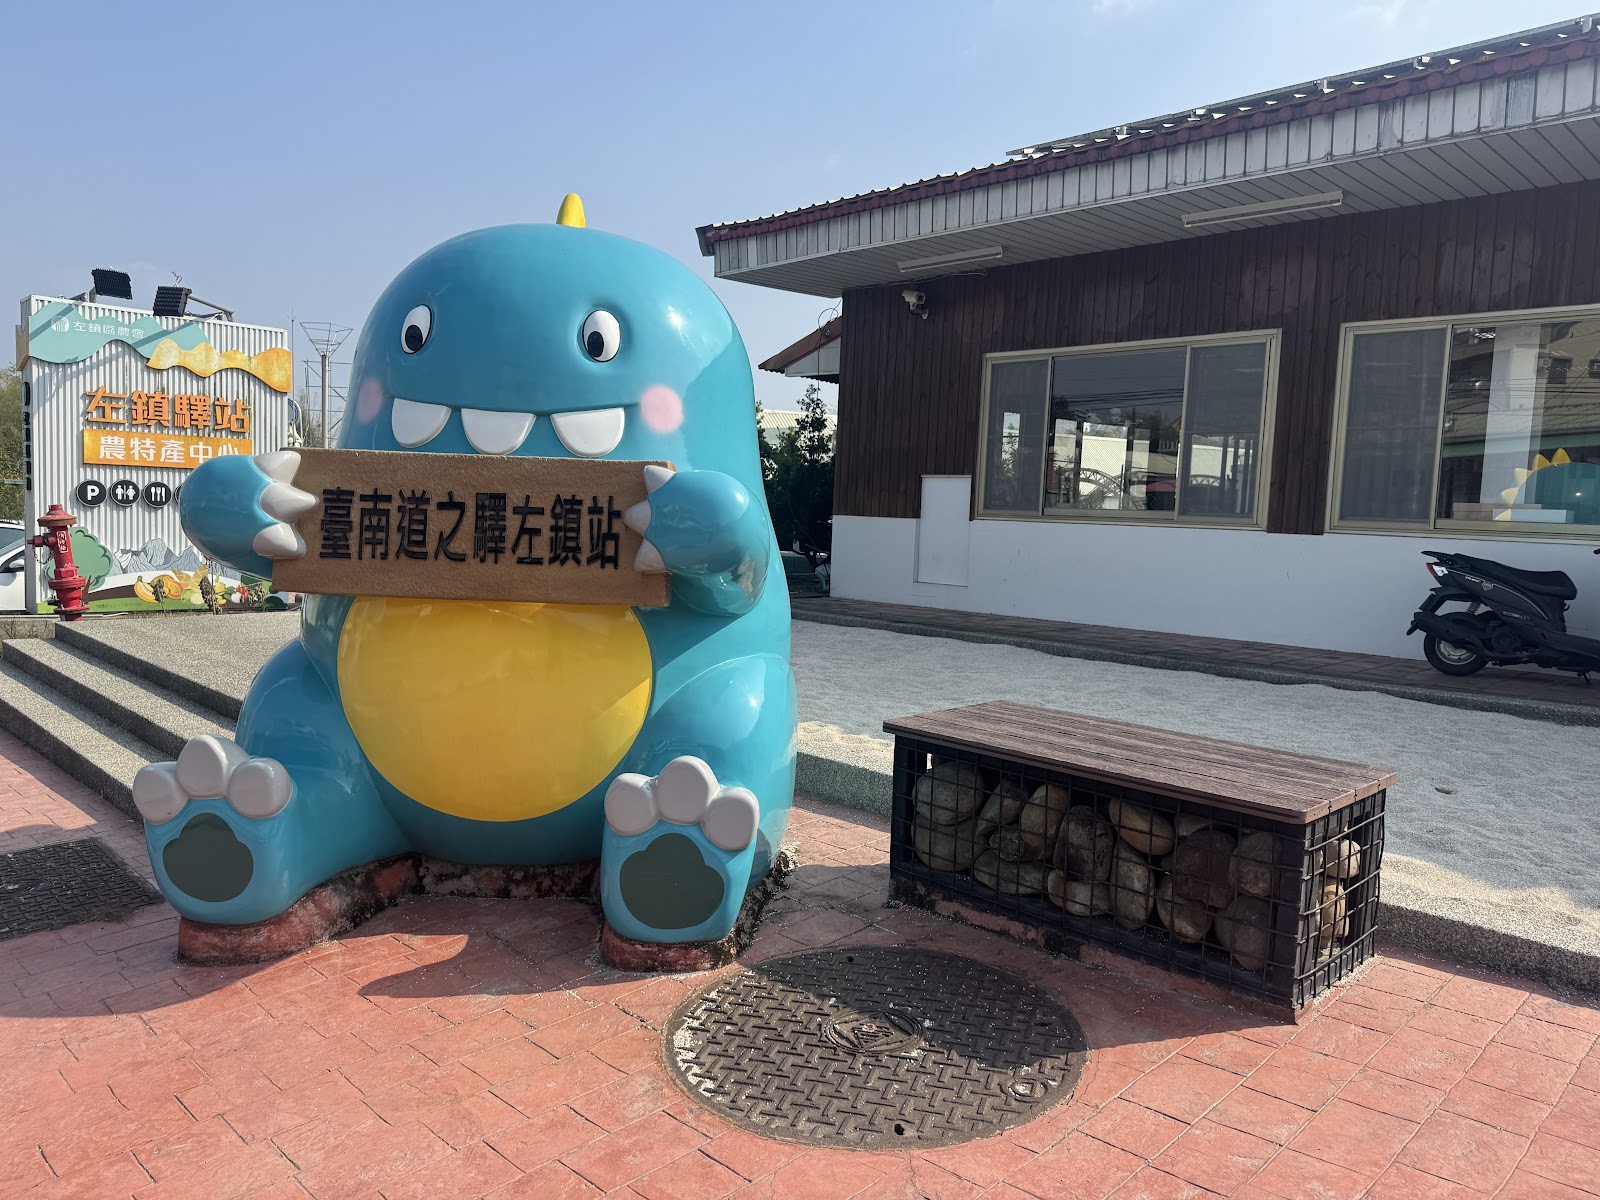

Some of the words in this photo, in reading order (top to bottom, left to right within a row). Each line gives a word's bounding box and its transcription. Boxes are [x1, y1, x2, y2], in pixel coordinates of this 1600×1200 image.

[73, 321, 145, 339] 左鎮區農會
[84, 385, 250, 433] 左鎮驛站
[87, 485, 100, 501] P
[319, 487, 622, 570] 臺南道之驛左鎮站
